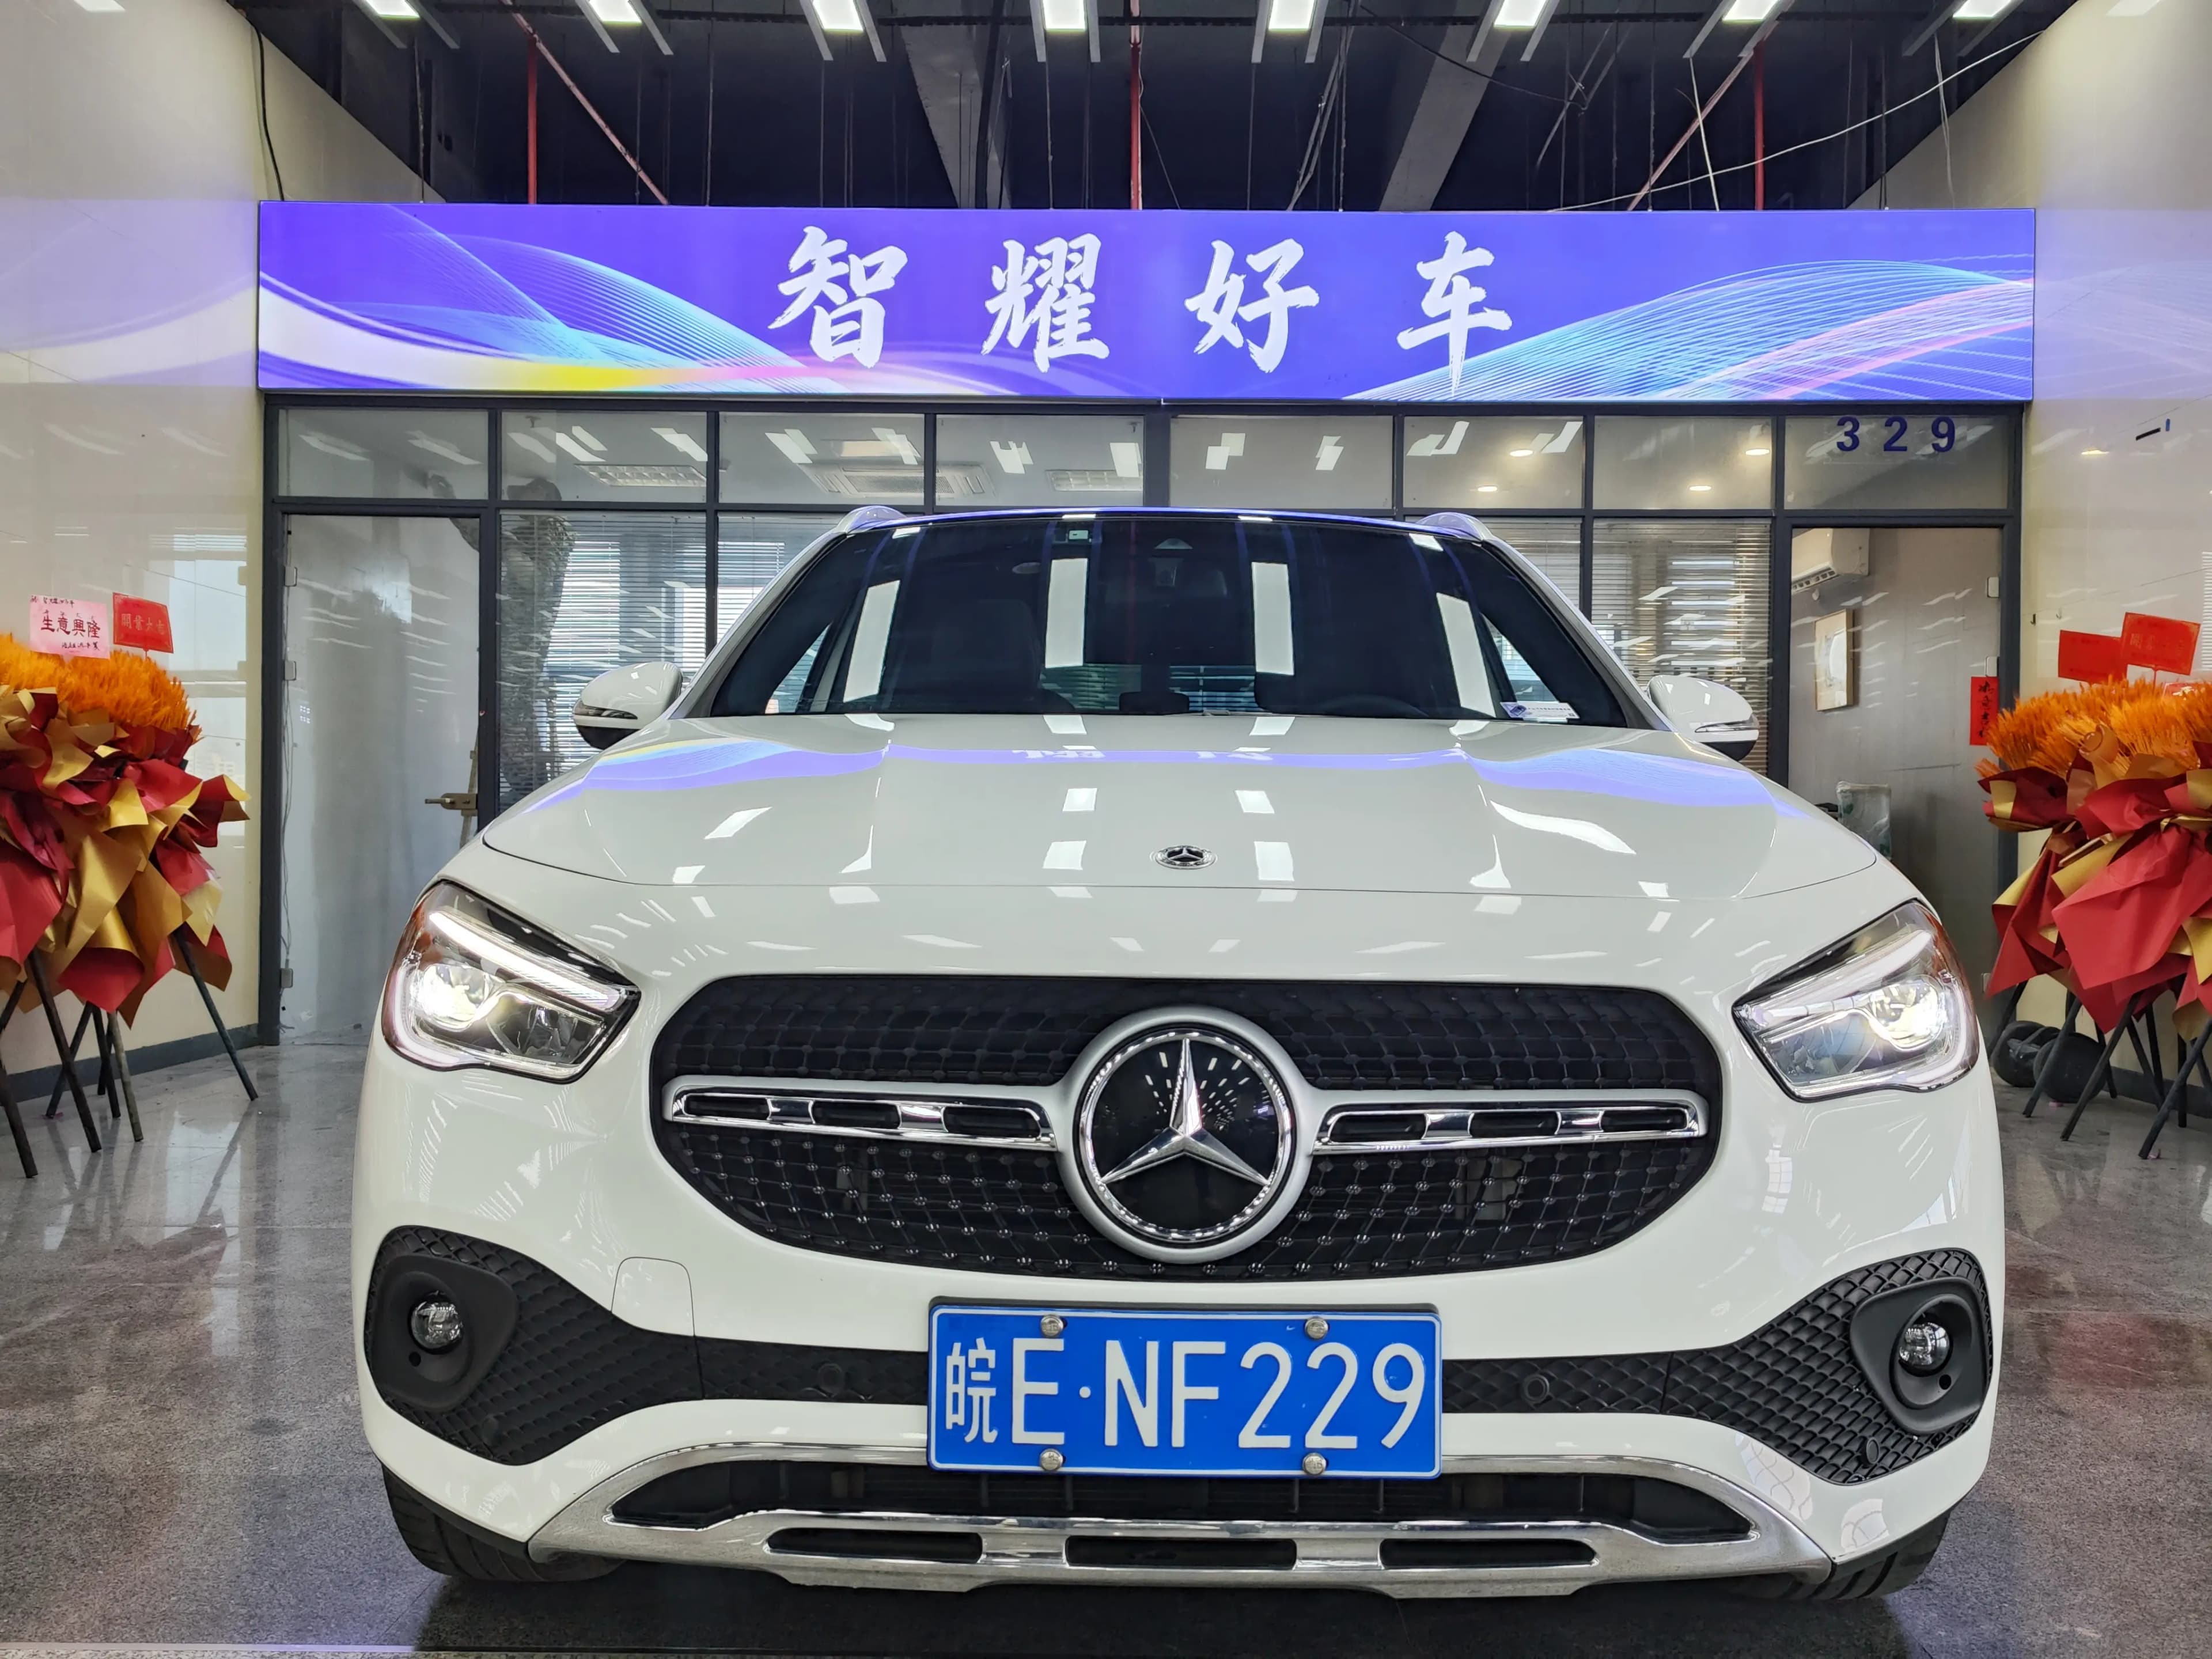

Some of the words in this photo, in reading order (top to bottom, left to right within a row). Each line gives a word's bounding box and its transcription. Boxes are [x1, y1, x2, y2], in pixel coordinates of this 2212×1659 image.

[768, 226, 1512, 397] 智耀好车
[1836, 416, 1956, 452] 329
[41, 615, 101, 638] 生意興隆
